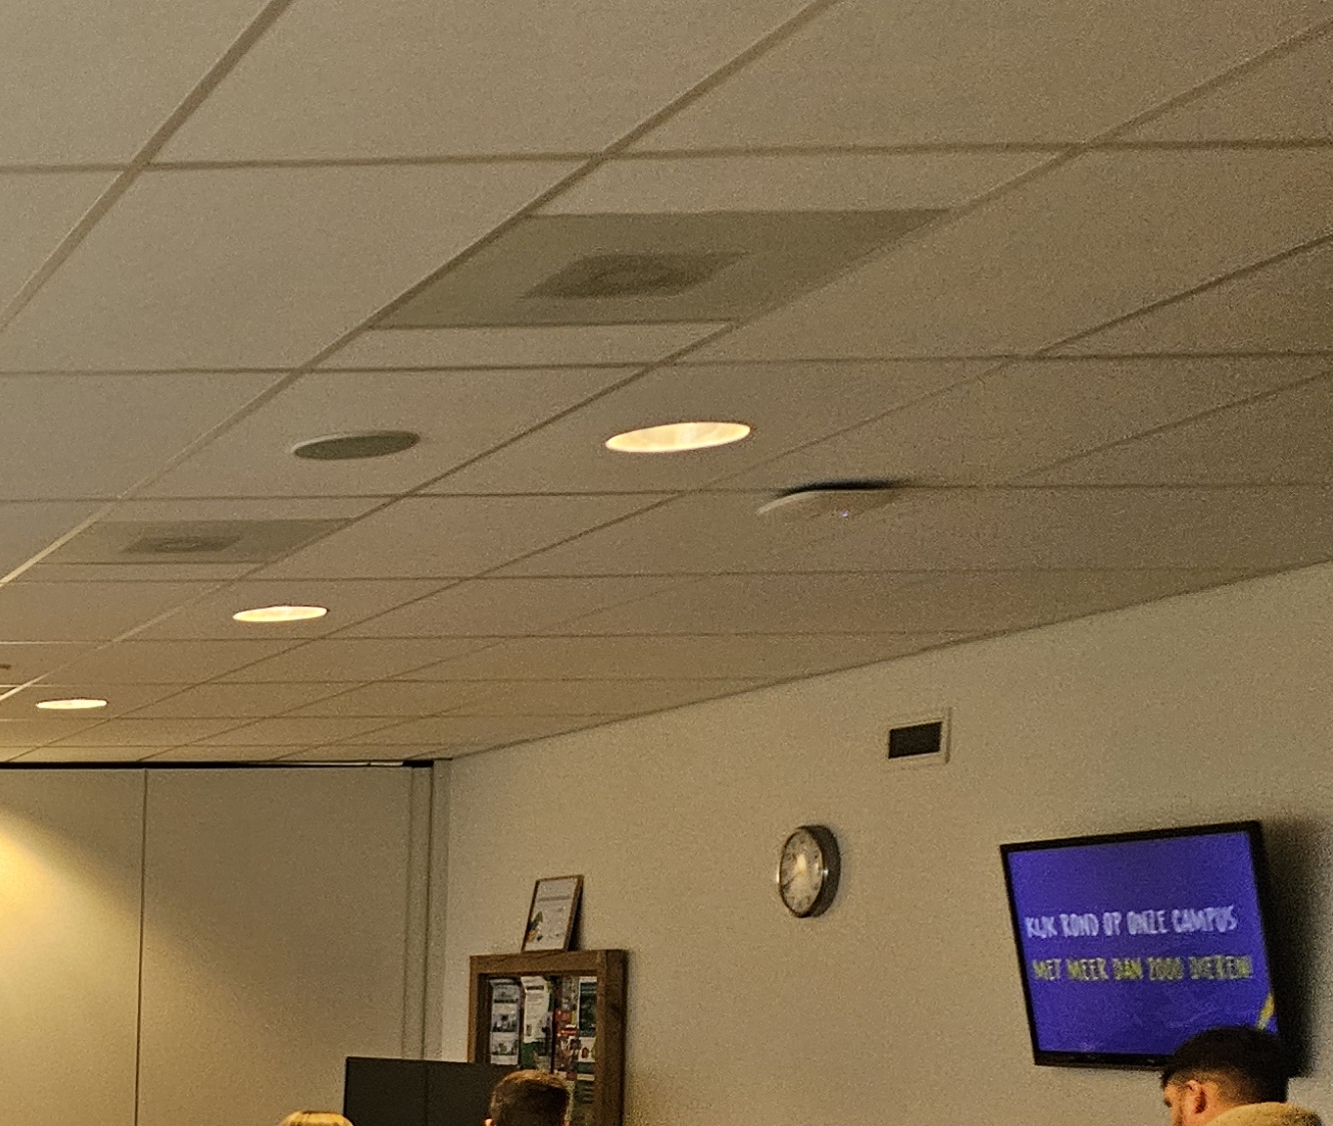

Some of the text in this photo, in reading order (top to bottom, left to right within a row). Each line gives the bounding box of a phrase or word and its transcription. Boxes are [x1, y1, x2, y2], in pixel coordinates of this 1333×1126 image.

[1059, 913, 1099, 938] ROND
[1103, 911, 1122, 936] OP
[1127, 909, 1169, 935] ONZE
[1171, 905, 1238, 933] CAMPUS
[1032, 958, 1062, 981] MET
[1066, 957, 1109, 981] MEER
[1112, 956, 1143, 981] DAN
